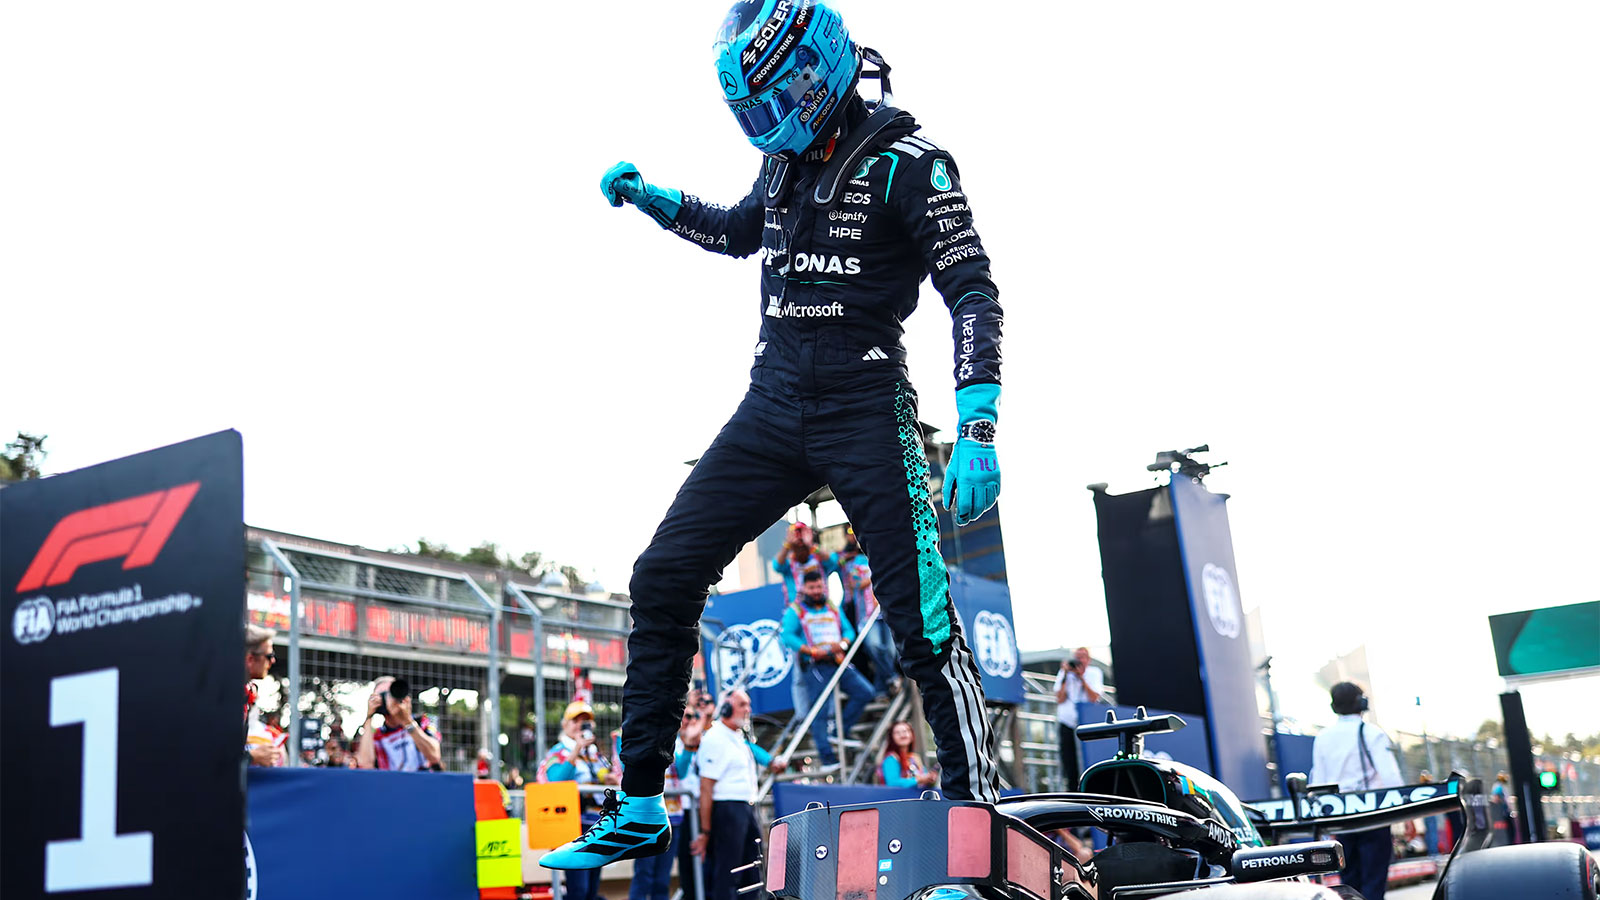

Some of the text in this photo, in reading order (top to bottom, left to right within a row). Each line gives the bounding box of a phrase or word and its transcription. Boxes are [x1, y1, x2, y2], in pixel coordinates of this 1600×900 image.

[754, 0, 791, 52] SOLER
[753, 33, 795, 84] CROWDSTRIKE
[732, 96, 764, 113] RONAS
[842, 192, 872, 205] EOS
[934, 203, 970, 217] SOLERA
[680, 224, 715, 245] Meta
[829, 226, 863, 240] HPE
[937, 215, 963, 233] IWC
[936, 246, 980, 271] BONVOY
[782, 301, 844, 319] Microsoft
[969, 457, 997, 472] nu
[15, 480, 202, 594] F1
[79, 587, 134, 610] Formula
[133, 583, 144, 602] 1
[56, 609, 96, 635] World
[44, 666, 153, 893] 1
[1249, 786, 1438, 820] TRONAS
[1095, 806, 1178, 828] CROWDSTRIKE
[1241, 854, 1305, 869] PETRONAS
